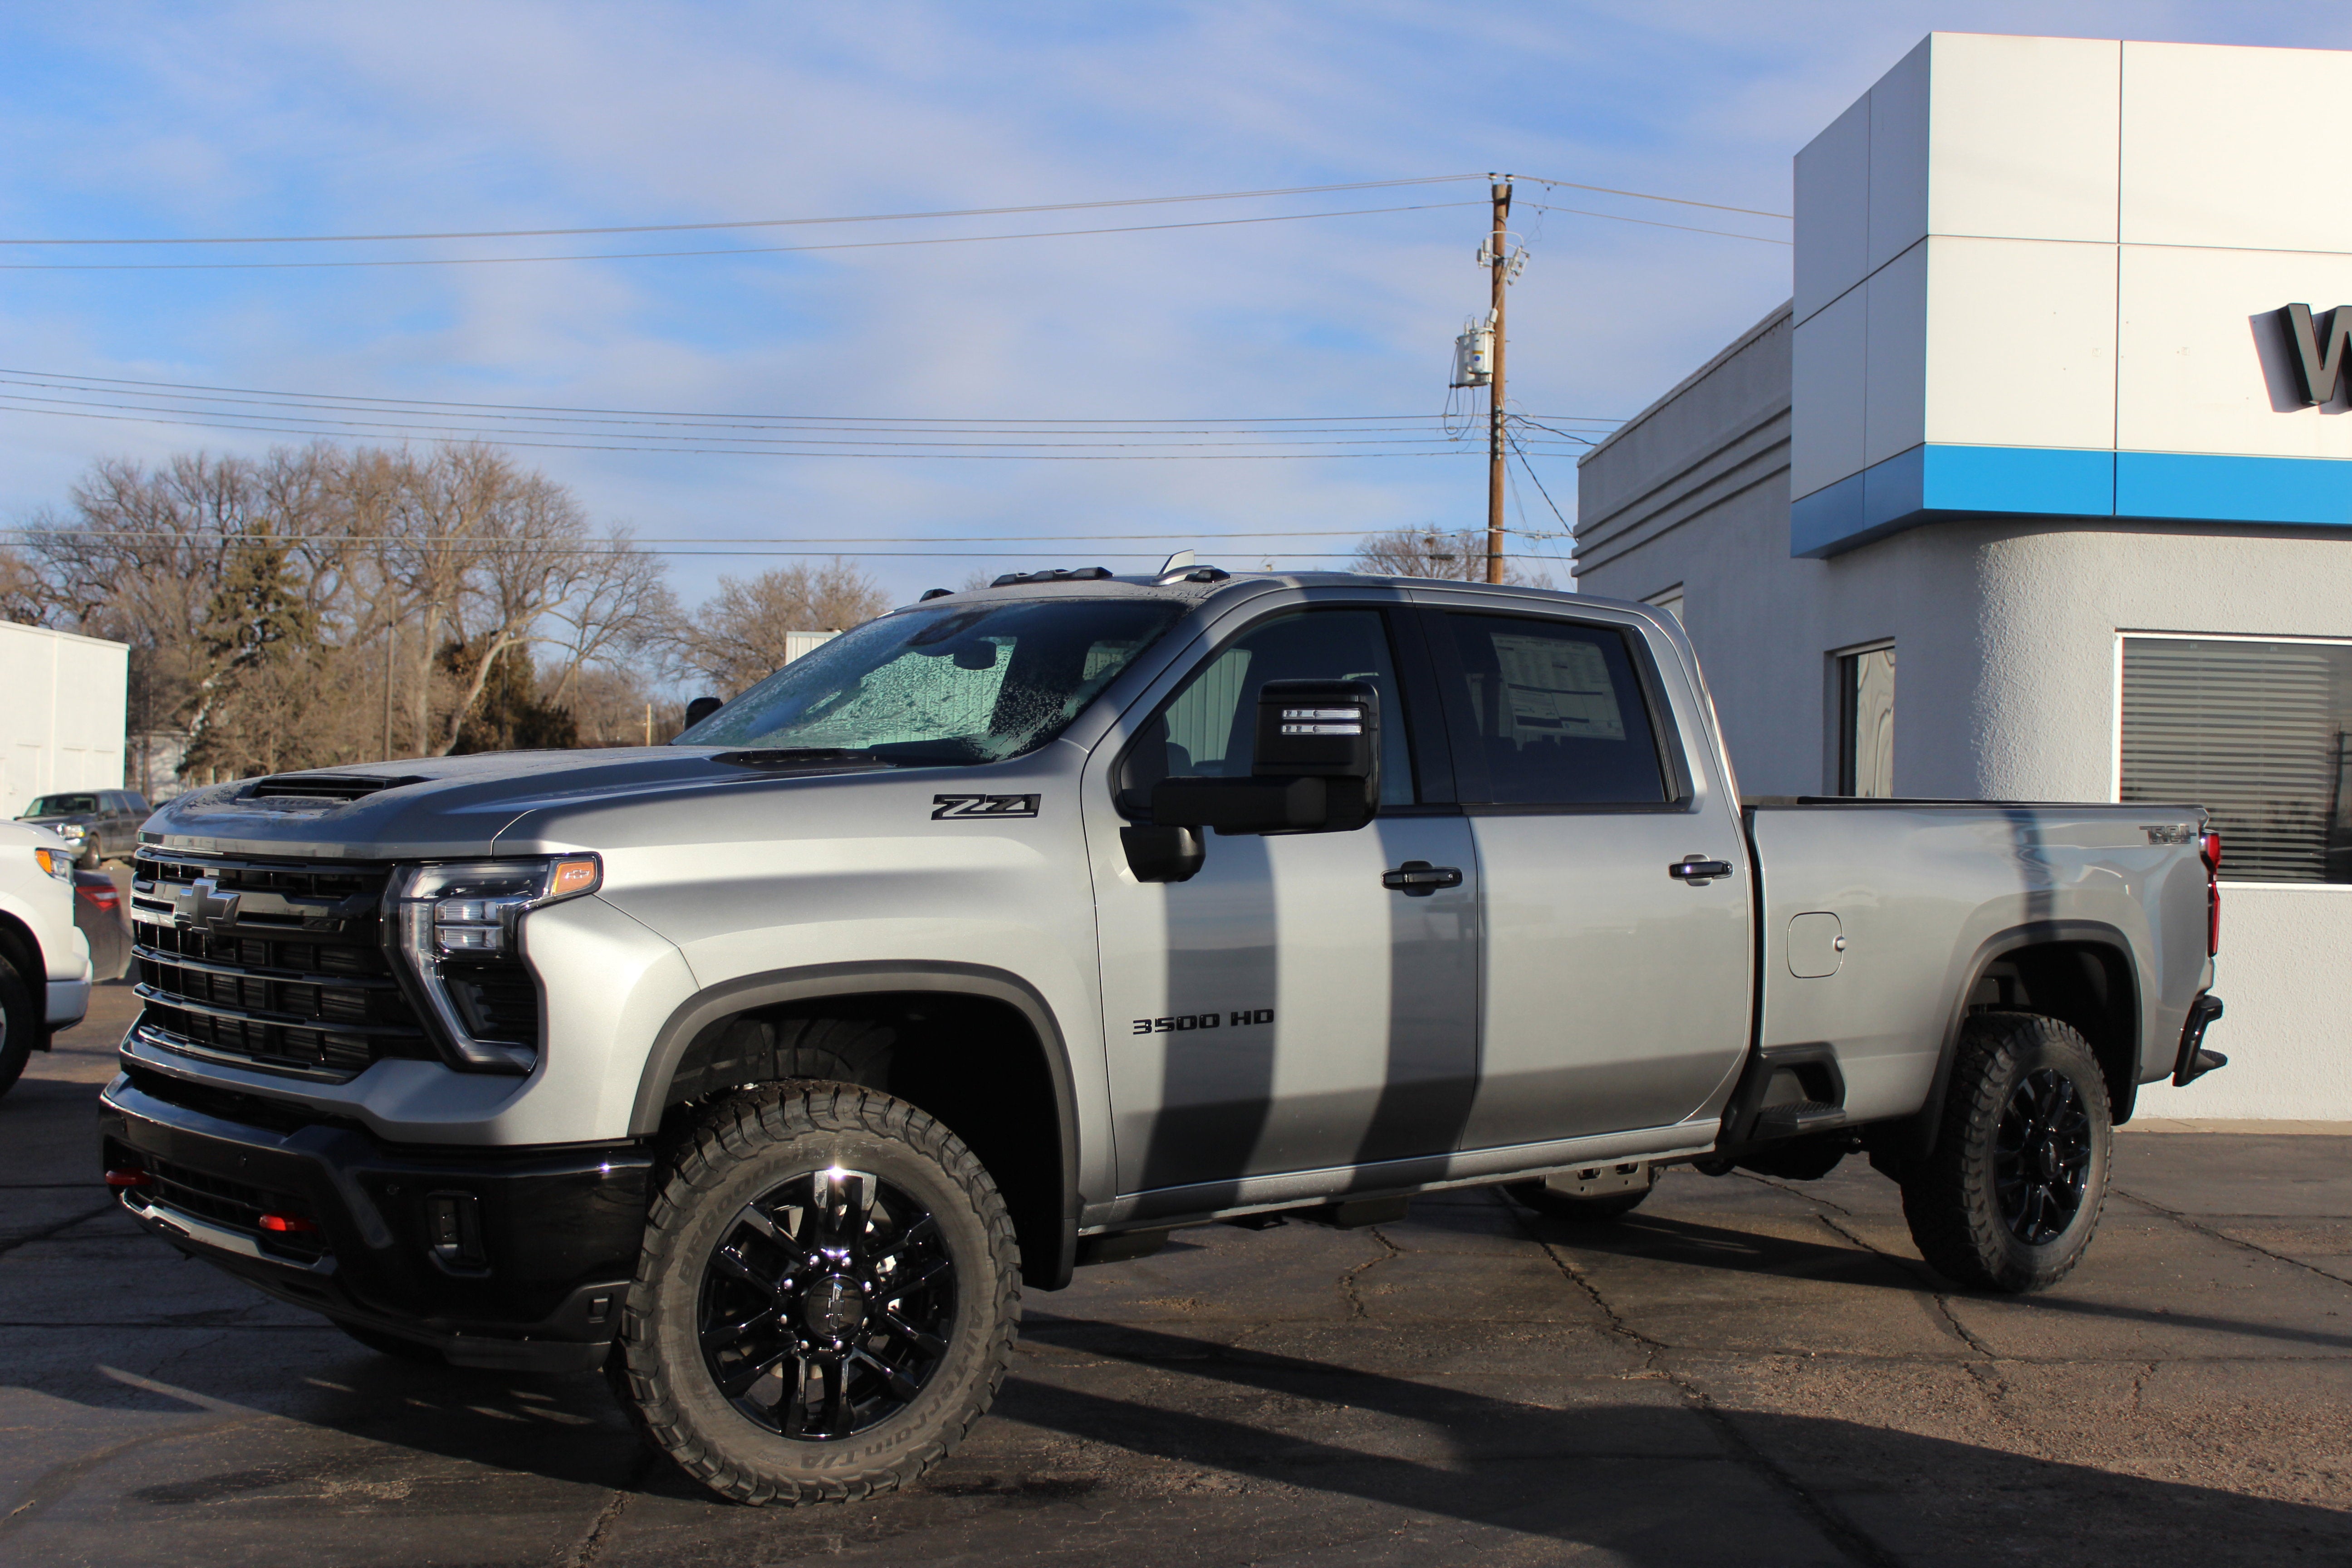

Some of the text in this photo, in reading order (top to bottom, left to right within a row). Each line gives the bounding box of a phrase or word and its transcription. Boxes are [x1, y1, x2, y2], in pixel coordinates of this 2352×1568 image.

[931, 794, 1042, 820] Z71
[2139, 826, 2197, 837] TRAIL
[2149, 836, 2191, 844] BOSS
[1133, 1009, 1274, 1035] 3500 HD
[865, 1303, 983, 1456] All-Terrain
[801, 1450, 858, 1469] T/A
